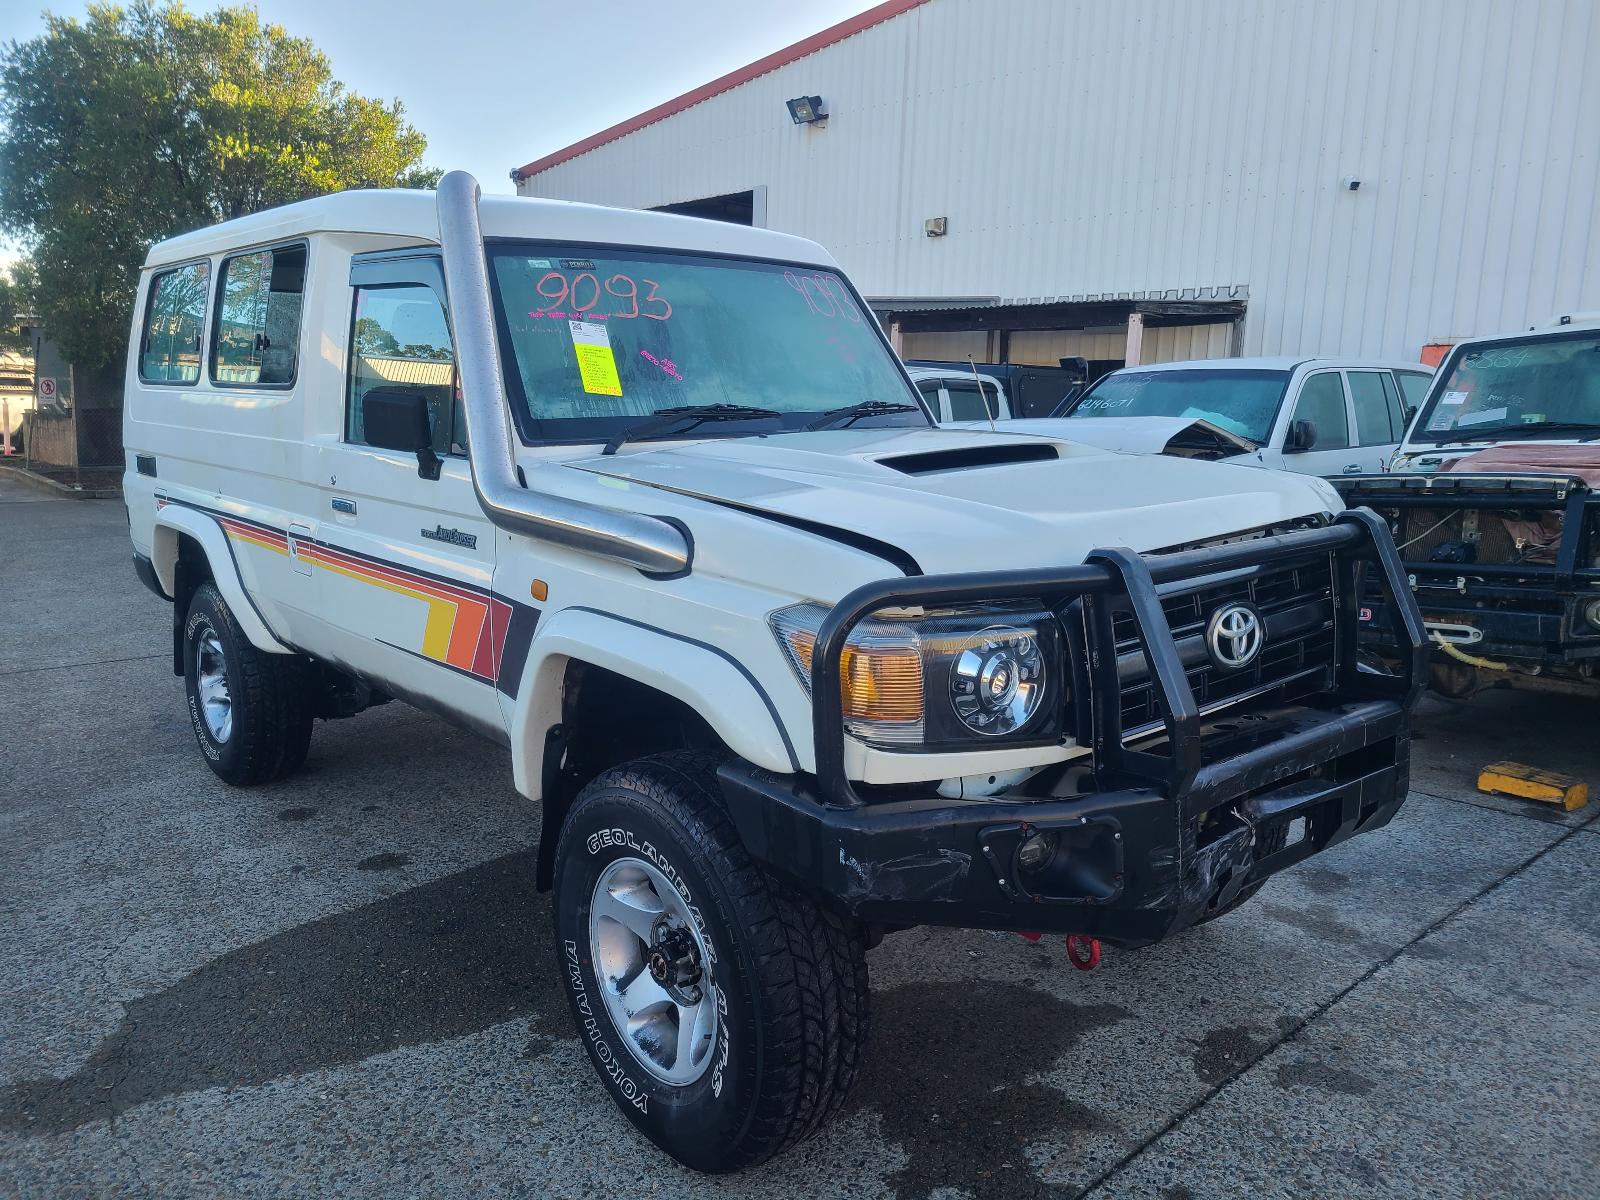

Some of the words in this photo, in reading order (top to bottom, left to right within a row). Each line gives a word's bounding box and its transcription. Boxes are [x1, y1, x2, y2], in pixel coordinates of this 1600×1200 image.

[536, 272, 673, 320] 9093
[784, 271, 860, 322] 9093
[586, 828, 718, 963] GEOLANDAR
[565, 940, 649, 1115] YOKOHAMA
